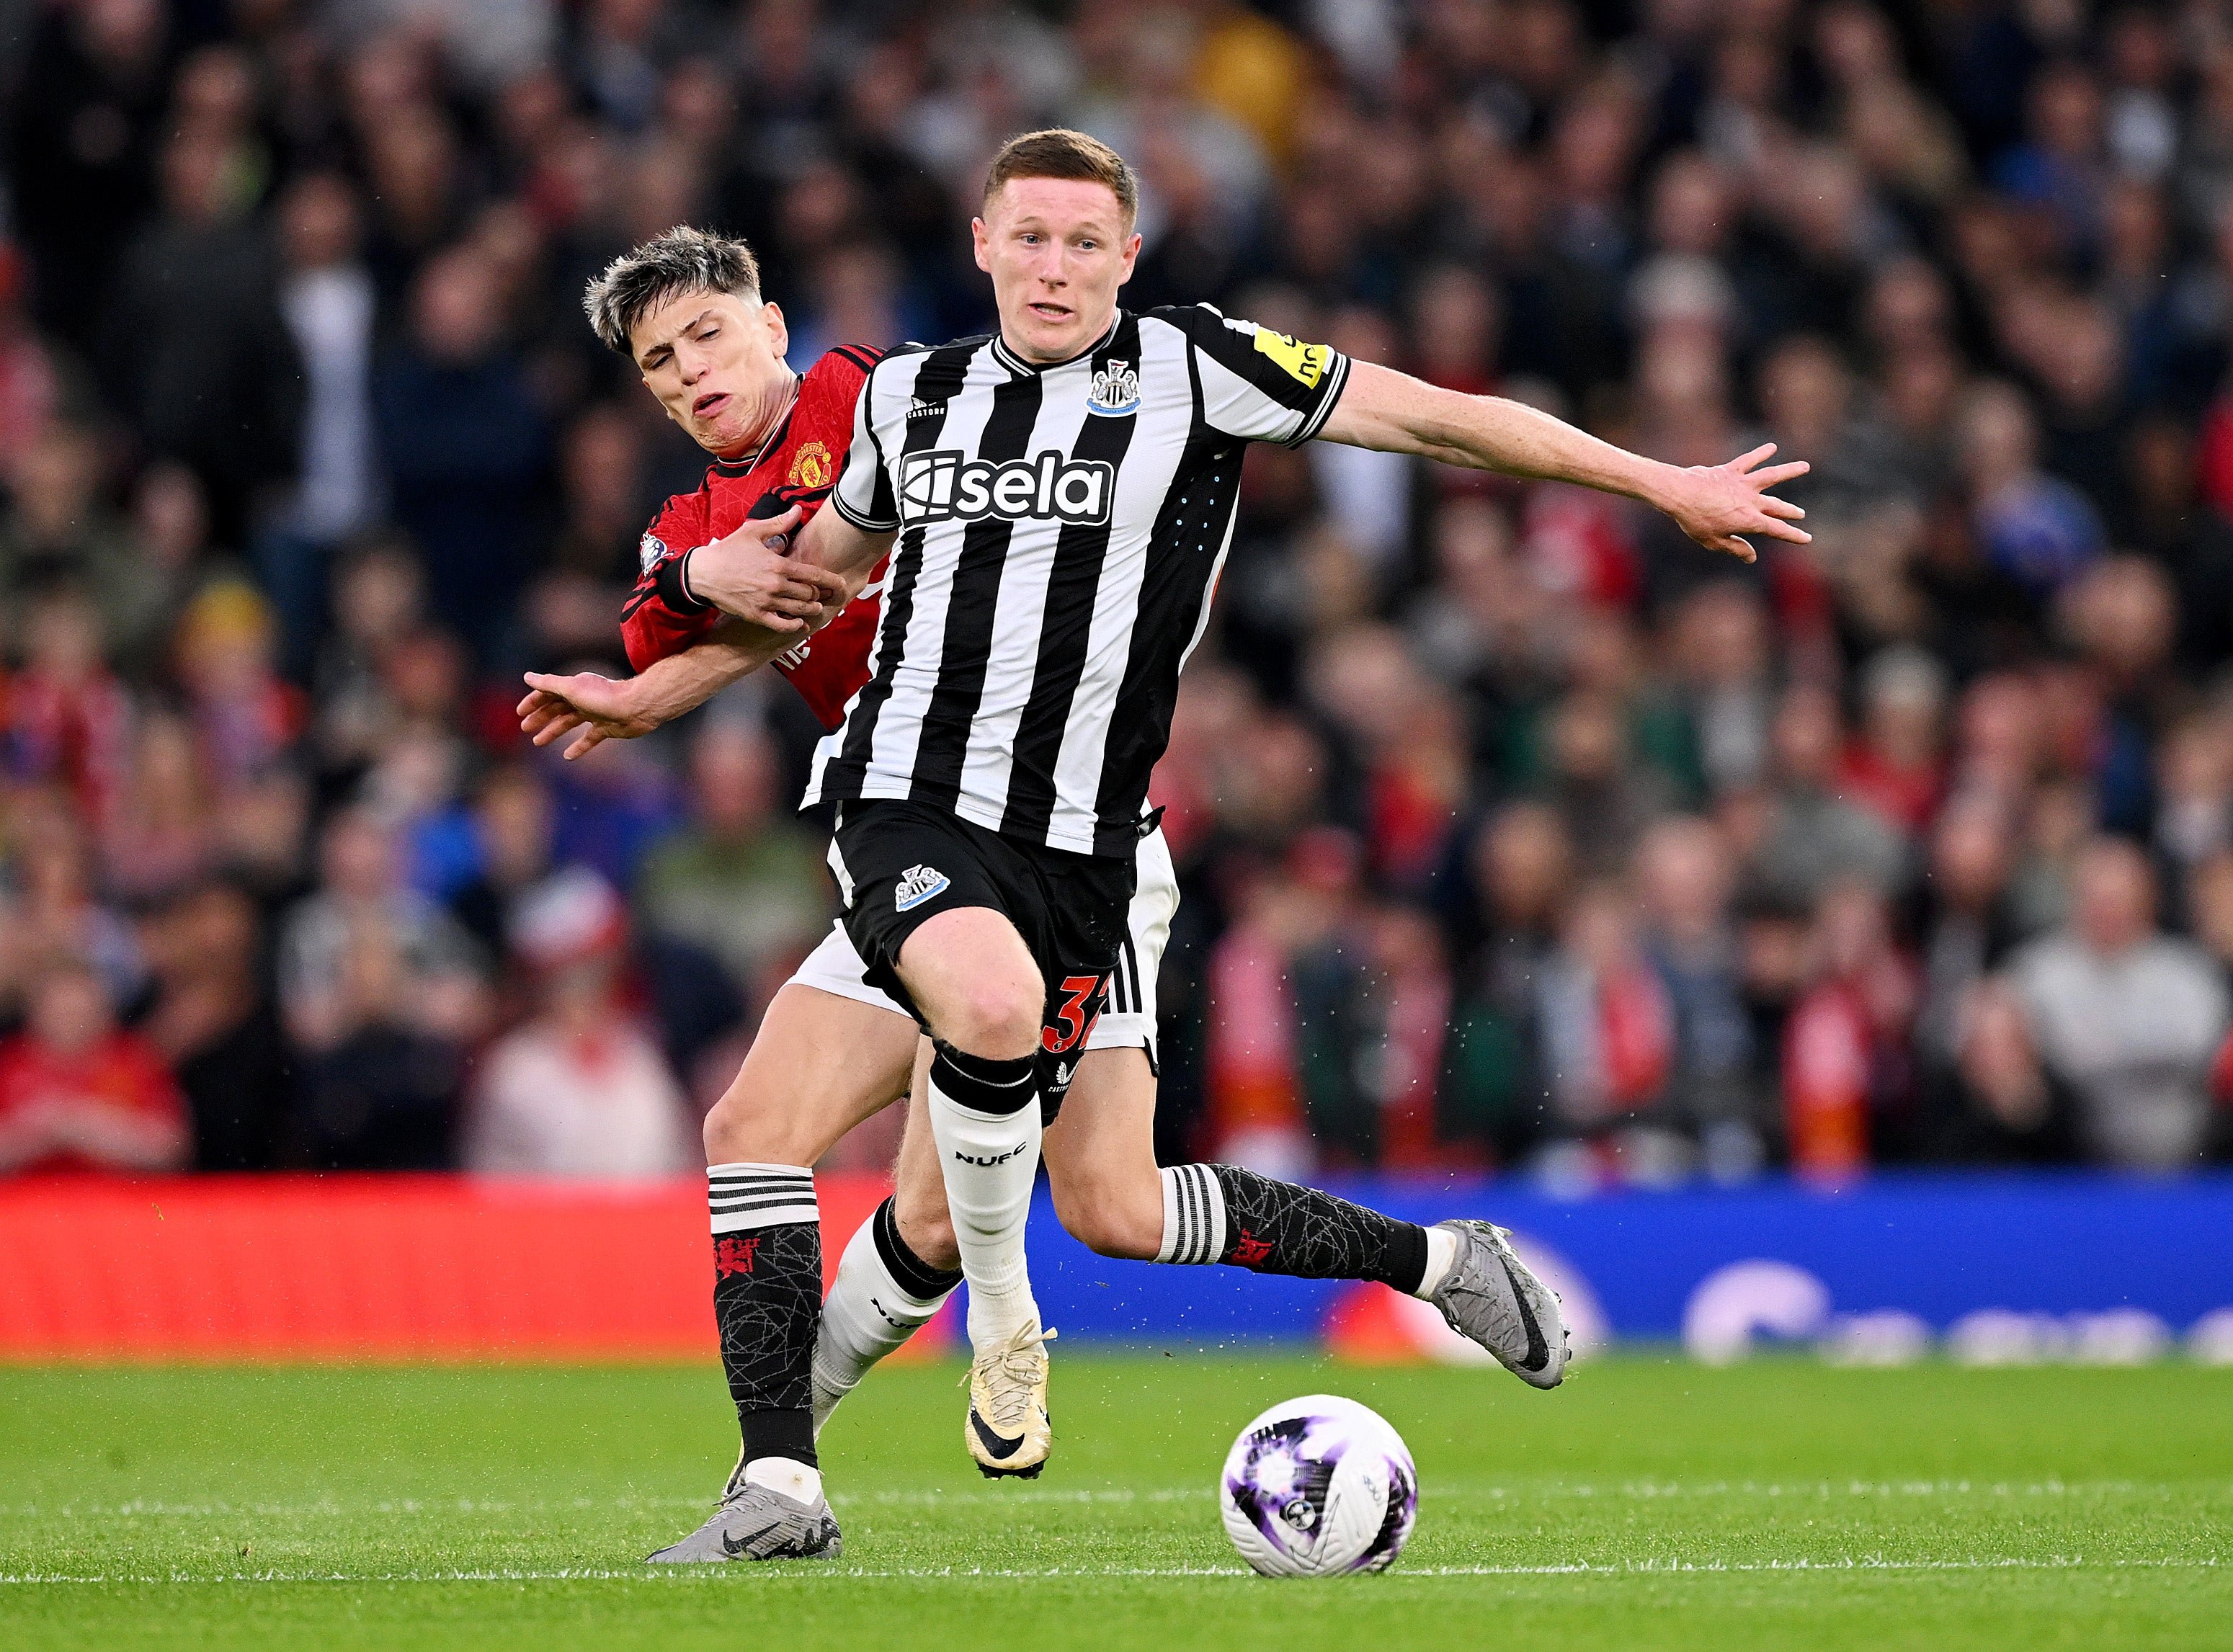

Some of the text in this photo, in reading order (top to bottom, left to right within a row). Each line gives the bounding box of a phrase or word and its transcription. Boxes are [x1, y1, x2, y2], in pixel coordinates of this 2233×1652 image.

[907, 407, 945, 419] CASTORE
[792, 445, 823, 479] MANCHESTER
[955, 456, 1103, 516] sela
[955, 1141, 1027, 1166] NUFC
